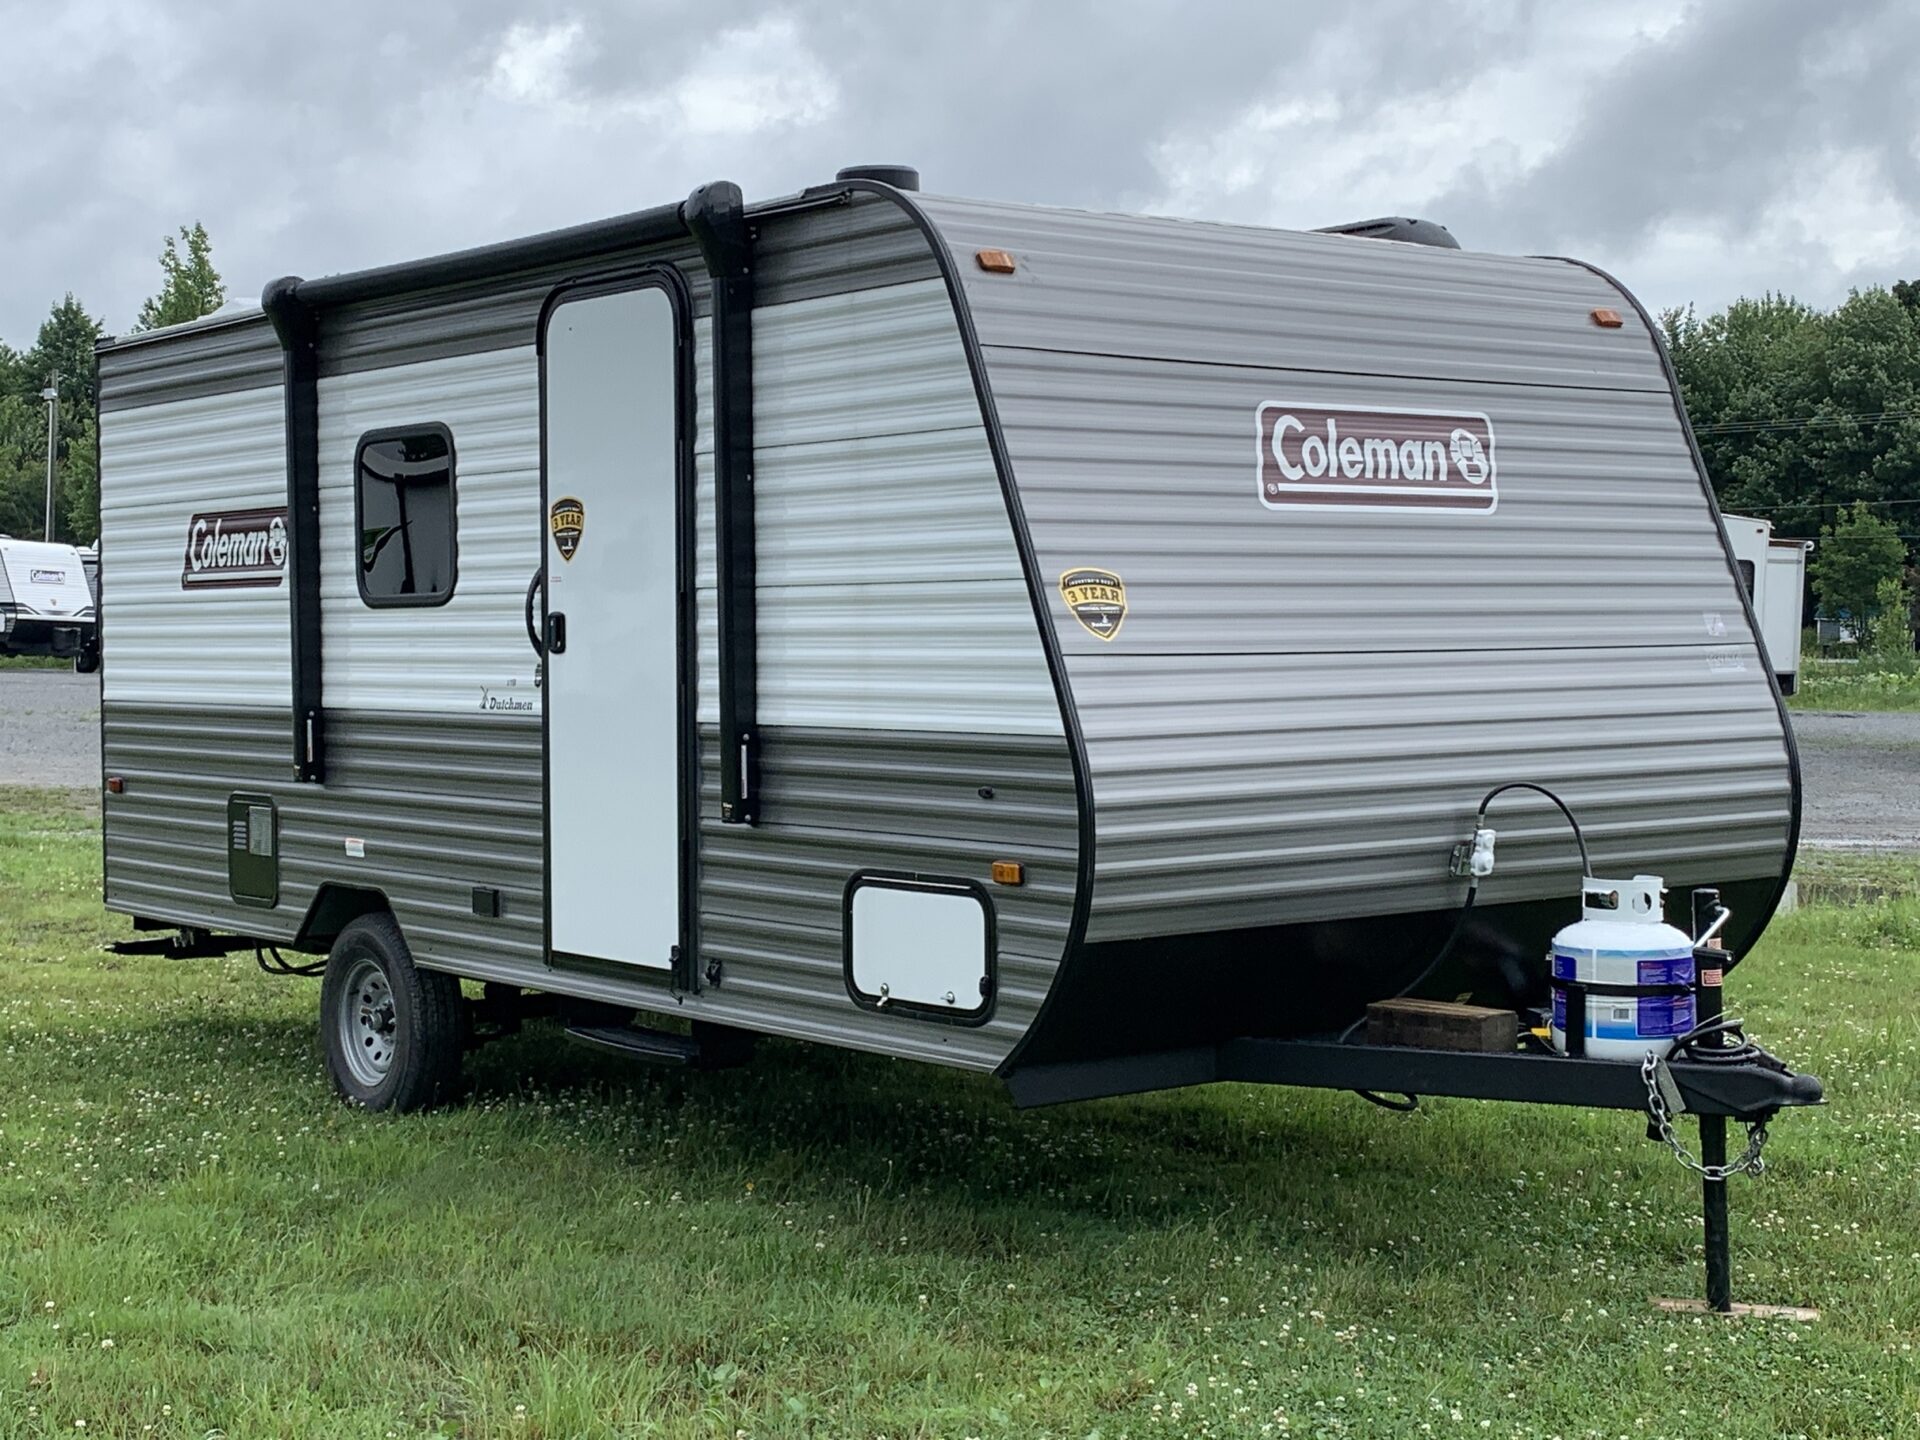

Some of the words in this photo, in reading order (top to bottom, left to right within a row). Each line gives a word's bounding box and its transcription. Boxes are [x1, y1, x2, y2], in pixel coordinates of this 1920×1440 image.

[1272, 415, 1448, 481] Coleman
[553, 518, 559, 529] 3
[560, 514, 581, 526] YEAR
[190, 518, 268, 572] Coleman
[1068, 590, 1078, 603] 3
[1079, 586, 1120, 602] YEAR
[489, 697, 533, 710] Dutchmen
